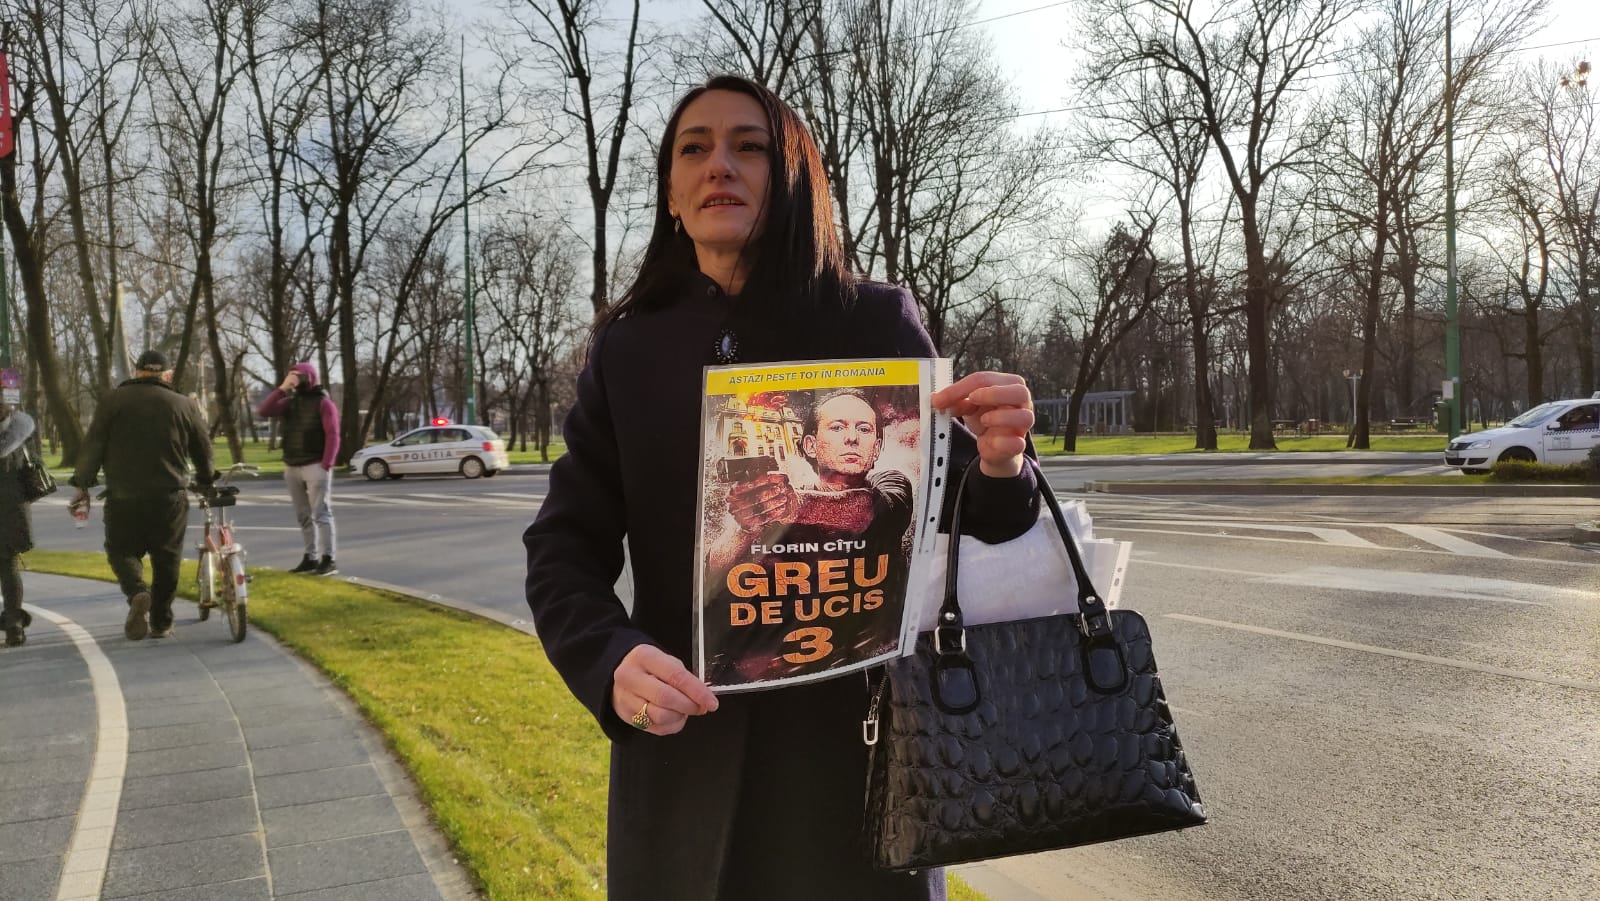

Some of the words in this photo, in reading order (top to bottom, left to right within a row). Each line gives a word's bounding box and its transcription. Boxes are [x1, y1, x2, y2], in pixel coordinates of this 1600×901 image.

[766, 372, 797, 382] PESTE
[800, 371, 819, 379] TOT
[750, 542, 819, 554] FLORIN
[726, 554, 889, 598] GREU
[730, 601, 783, 626] DE
[794, 589, 884, 621] UCIS
[782, 626, 834, 664] 3
